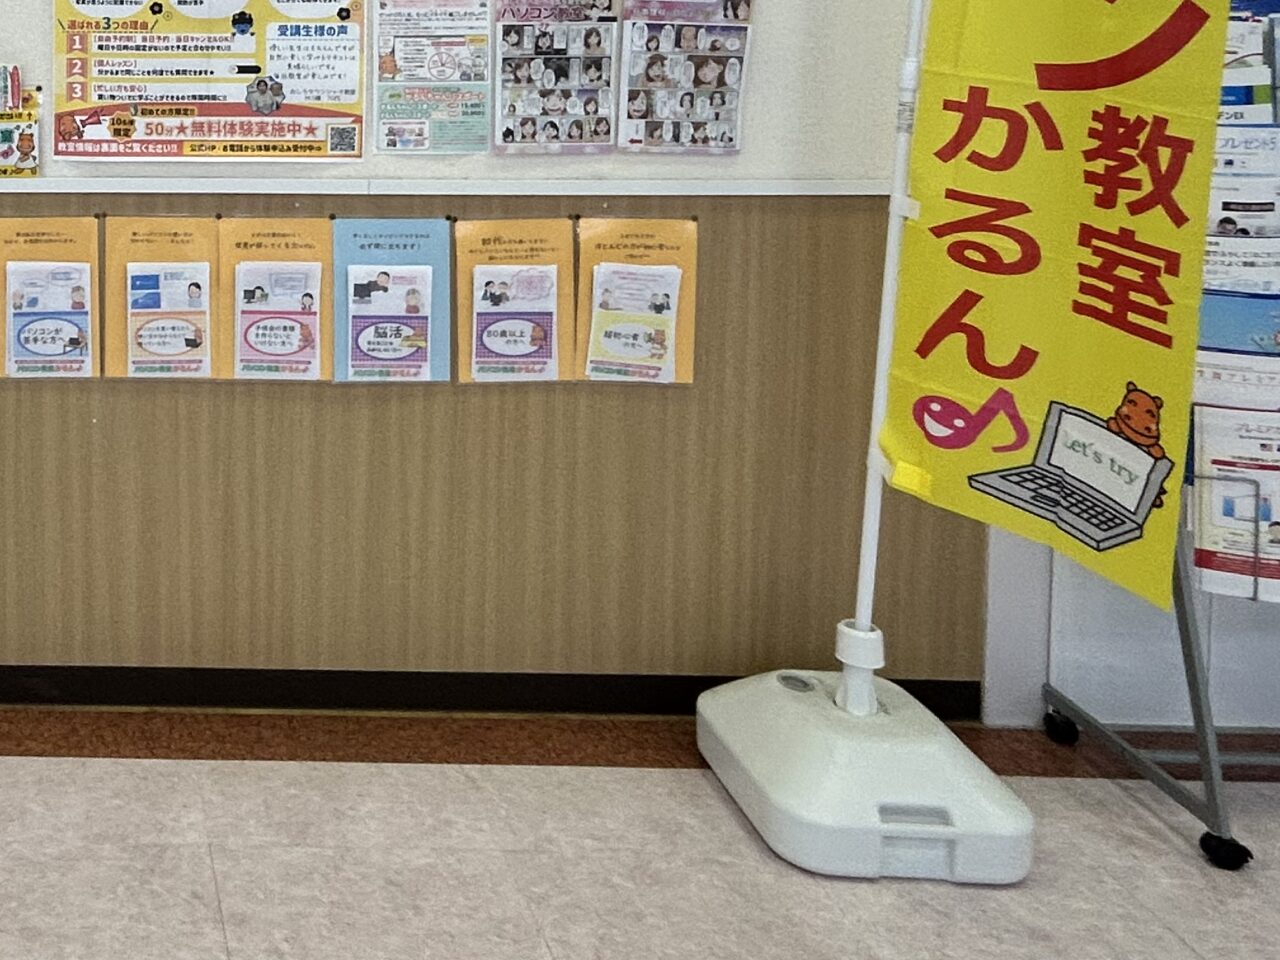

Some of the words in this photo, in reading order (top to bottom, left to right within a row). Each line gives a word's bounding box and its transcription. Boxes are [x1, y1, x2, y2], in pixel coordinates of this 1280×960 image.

[67, 16, 149, 30] 選ばれる3つの理由
[277, 24, 348, 37] 受講生様の声
[72, 36, 82, 49] 1
[71, 60, 82, 73] 2
[71, 84, 82, 97] 3
[1072, 104, 1194, 350] 教室
[373, 325, 404, 339] 脳活
[1109, 456, 1140, 486] try
